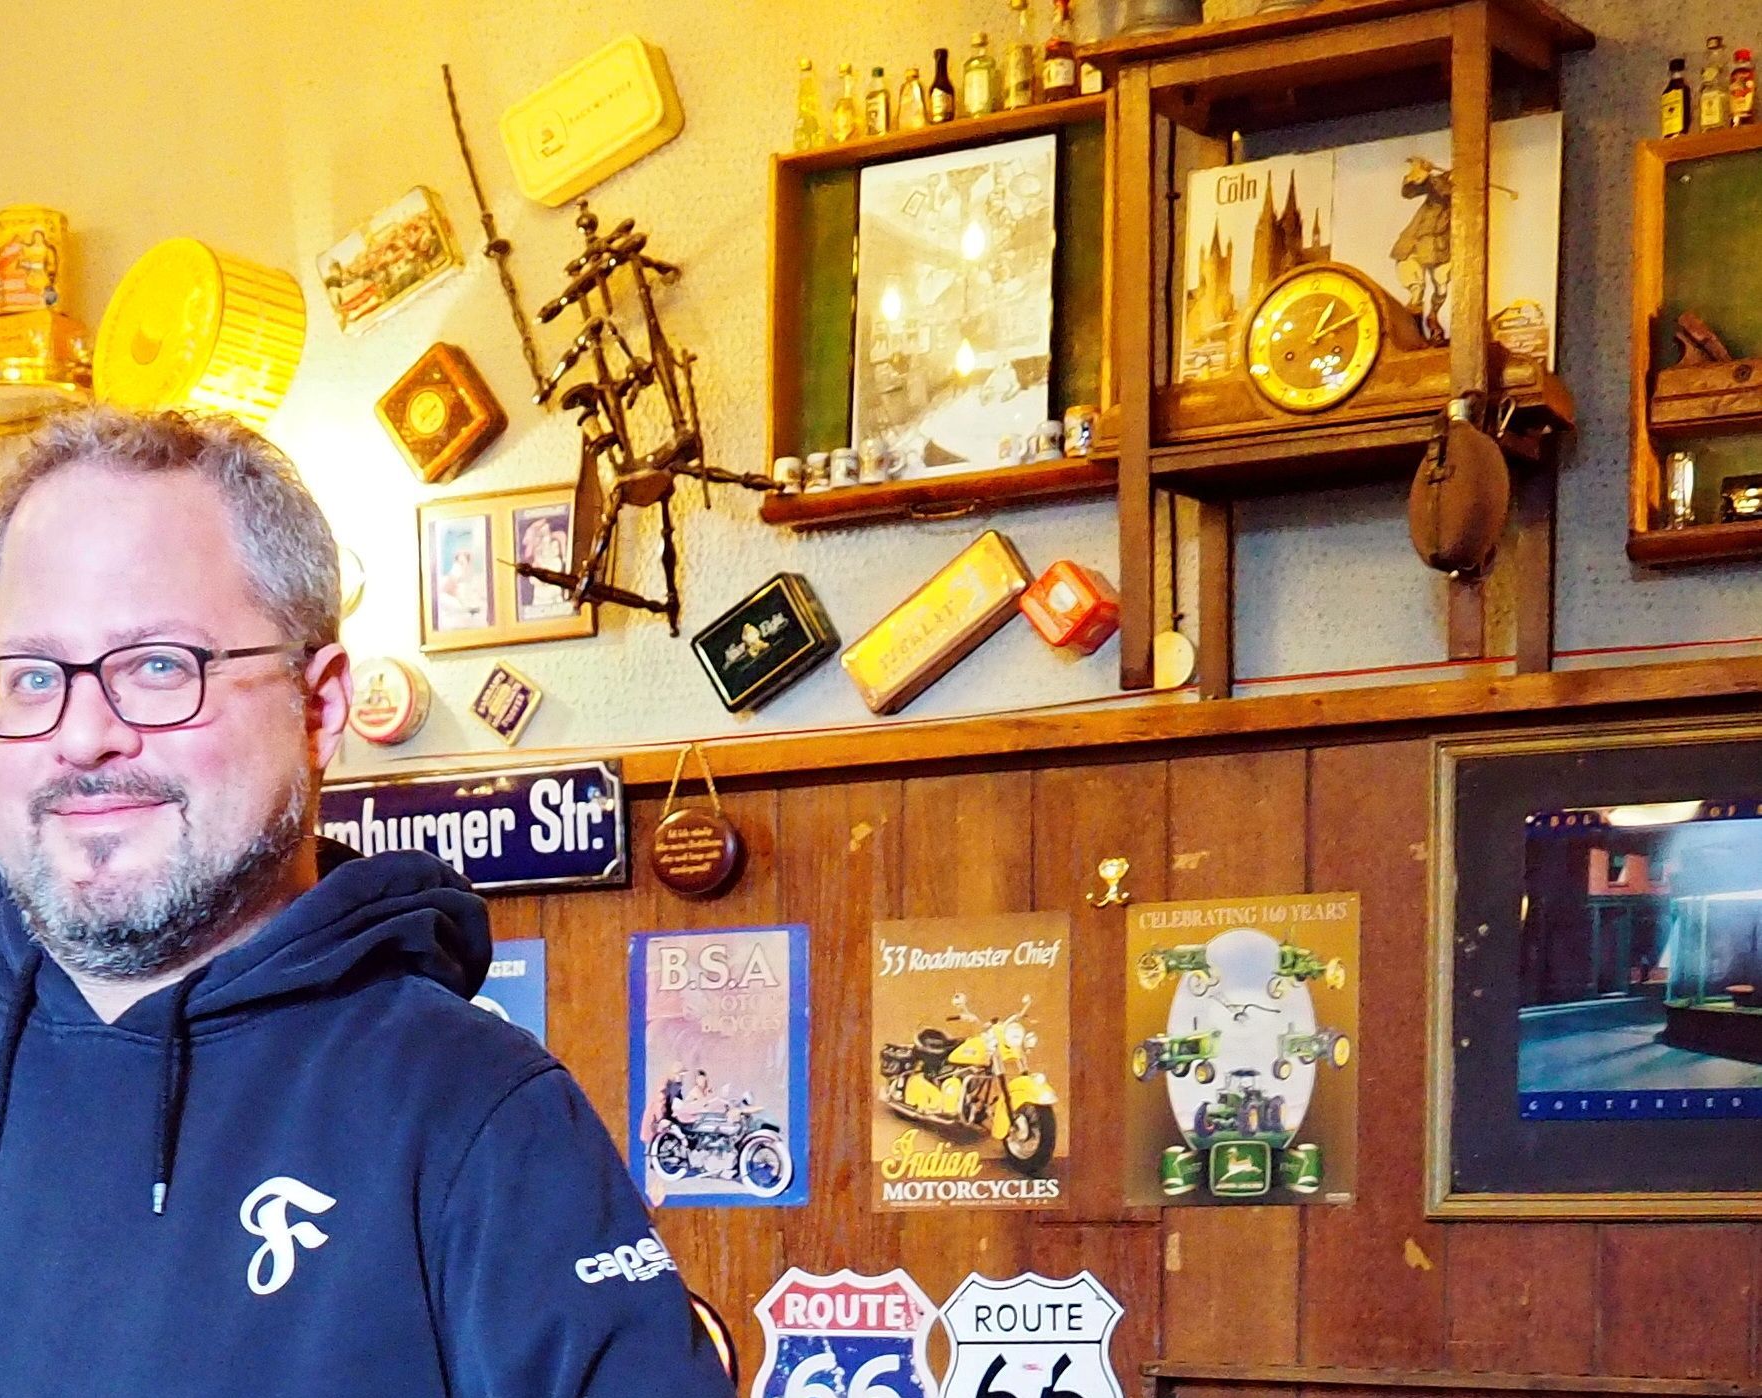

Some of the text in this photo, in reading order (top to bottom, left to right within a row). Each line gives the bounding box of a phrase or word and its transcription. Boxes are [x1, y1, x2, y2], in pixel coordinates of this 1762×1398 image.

[322, 778, 603, 875] mburger Str.
[1139, 905, 1258, 930] CELEBRATING
[1291, 902, 1348, 922] YEARS
[908, 945, 1013, 972] Roadmaster
[1013, 938, 1063, 969] Chief
[880, 1128, 983, 1180] Indian
[881, 1178, 1060, 1201] MOTORCYCLES
[784, 1292, 907, 1328] ROUTE
[975, 1303, 1084, 1333] ROUTE
